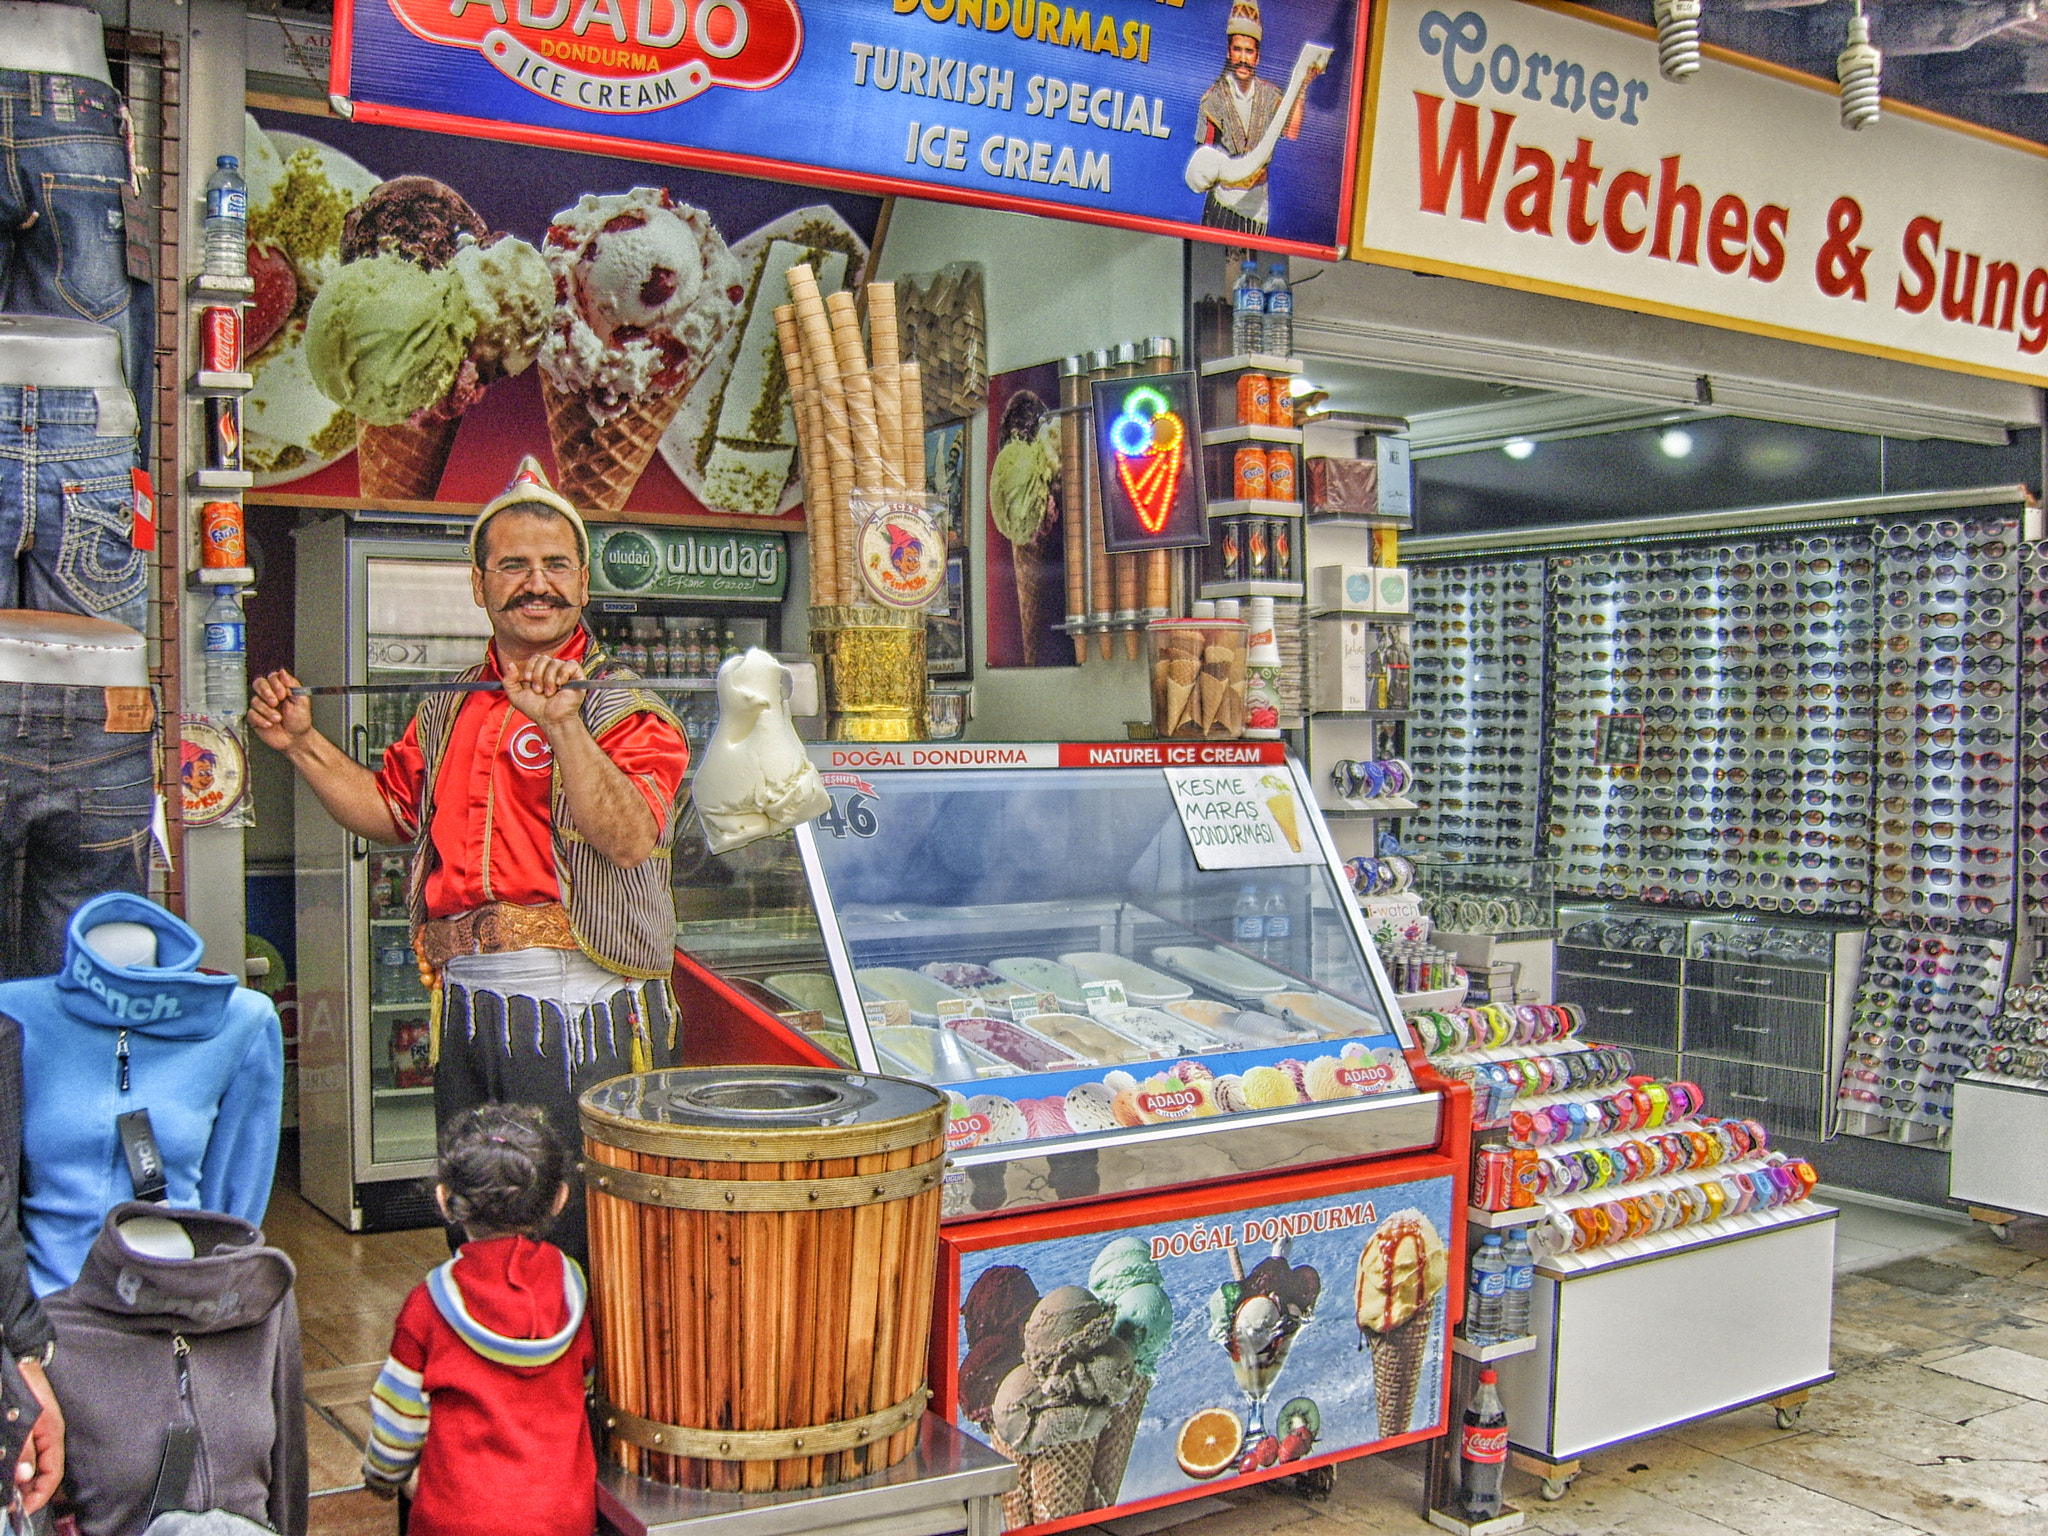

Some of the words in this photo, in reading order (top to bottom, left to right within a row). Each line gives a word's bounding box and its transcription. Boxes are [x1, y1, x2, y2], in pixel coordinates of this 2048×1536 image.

[540, 39, 661, 73] DONDURMA
[1419, 10, 1650, 127] Corner
[515, 57, 567, 98] ICE
[578, 77, 678, 108] CREAM
[850, 41, 1016, 110] TURKISH
[1026, 74, 1172, 140] SPECIAL
[905, 121, 970, 171] ICE
[980, 134, 1112, 194] CREAM
[1412, 91, 1790, 284] Watches
[1815, 195, 1874, 302] &
[888, 504, 920, 514] ECEM
[211, 527, 239, 544] Fanta
[608, 550, 651, 567] uludağ
[667, 537, 779, 585] uludağ
[180, 712, 210, 724] CEM
[832, 747, 905, 767] DOĞAL
[913, 749, 1028, 765] DONDURMA
[1089, 749, 1162, 765] NATUREL
[1167, 747, 1196, 764] ICE
[1200, 746, 1261, 763] CREAM
[1176, 778, 1246, 797] KESME
[817, 792, 879, 838] 46
[1185, 800, 1259, 821] MARAŞ
[1190, 822, 1275, 847] DONDURMASI
[1344, 1067, 1387, 1083] ADADO
[1147, 1092, 1196, 1109] ADADO
[1149, 1223, 1234, 1262] DOĞAL
[1243, 1200, 1378, 1243] DONDURMA
